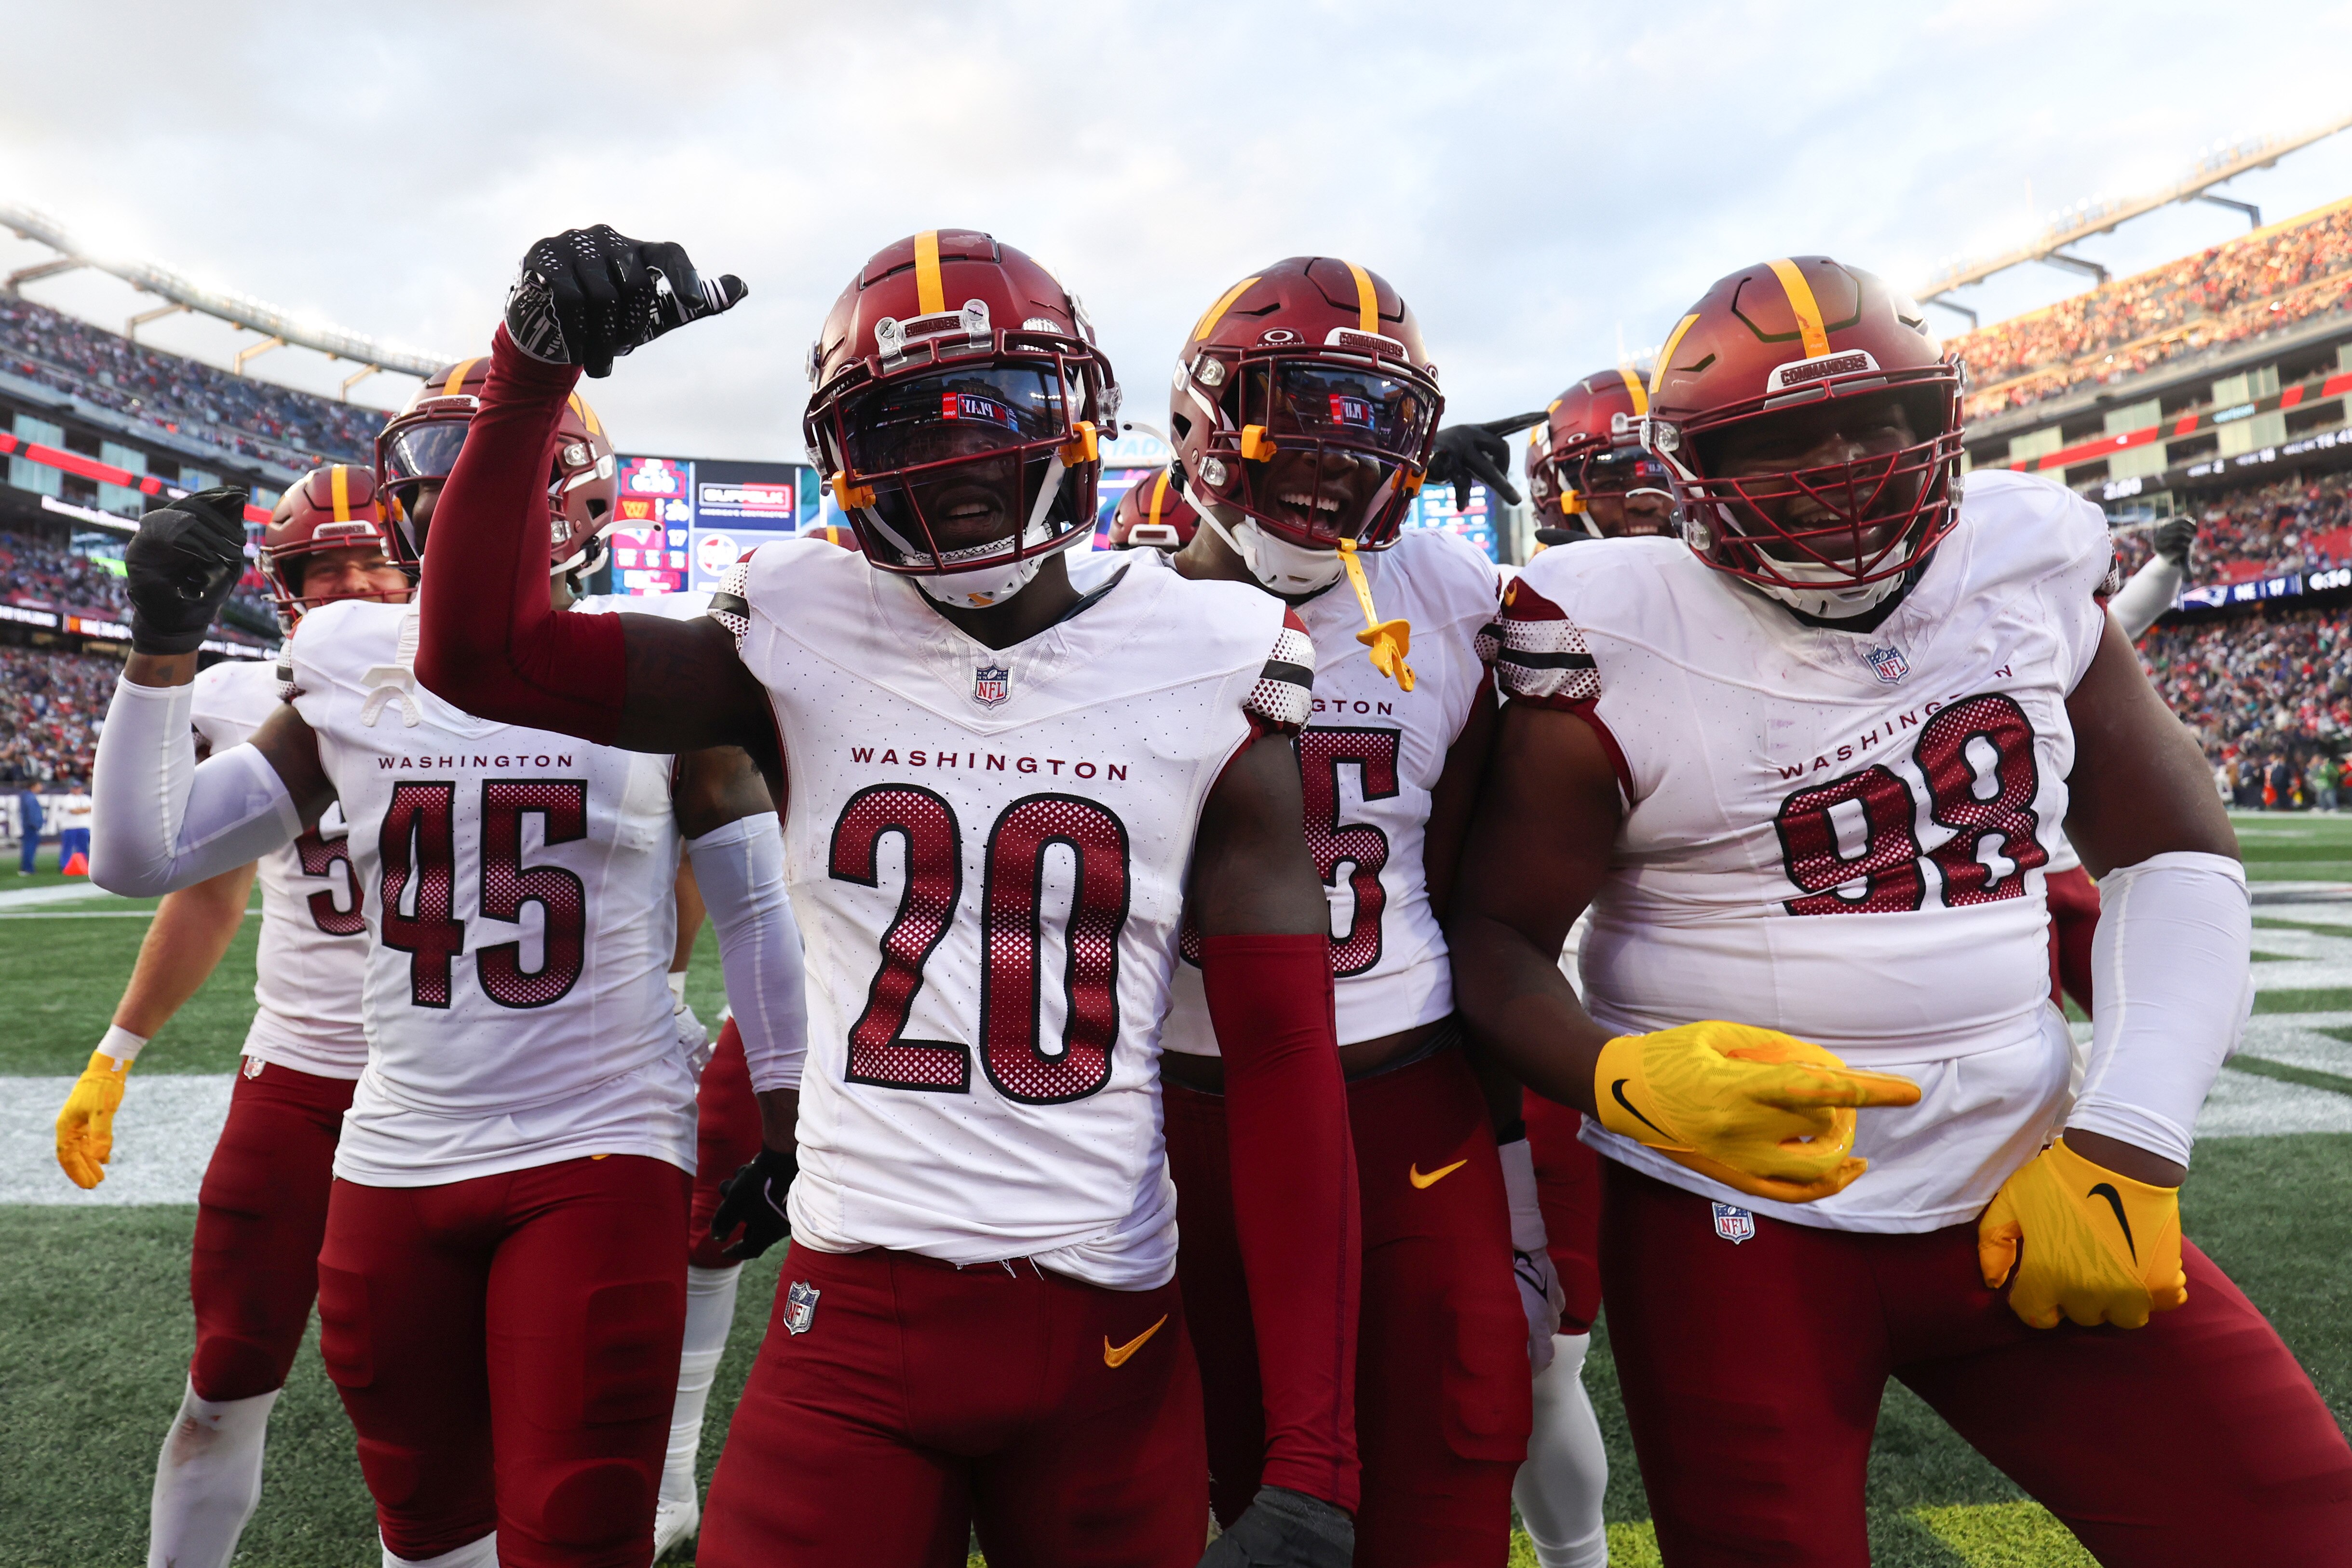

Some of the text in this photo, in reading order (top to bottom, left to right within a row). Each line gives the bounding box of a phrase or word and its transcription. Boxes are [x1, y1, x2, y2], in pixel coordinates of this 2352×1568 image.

[905, 318, 960, 337] COMMANDERS
[1339, 333, 1404, 358] COMMANDERS
[1781, 355, 1867, 383] COMMANDERS
[1877, 659, 1906, 676] NFL
[978, 681, 1004, 700] NFL
[1777, 664, 2013, 780] WASHINGN
[378, 755, 573, 769] WASHINGTON
[851, 747, 1128, 781] WASHINGTON
[1773, 692, 2050, 917] 98
[378, 778, 587, 1009] 45
[828, 782, 1131, 1105] 20
[1720, 1218, 1748, 1235] NFL
[786, 1302, 809, 1326] NFL
